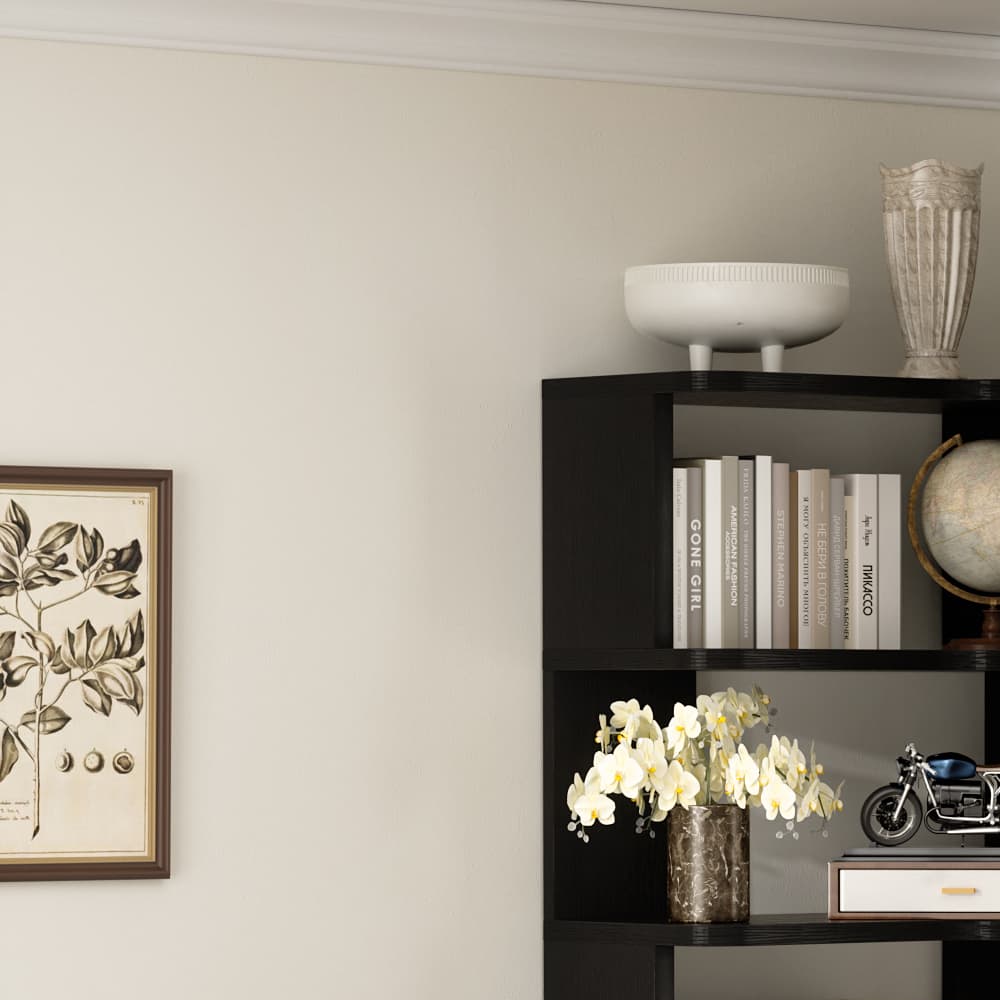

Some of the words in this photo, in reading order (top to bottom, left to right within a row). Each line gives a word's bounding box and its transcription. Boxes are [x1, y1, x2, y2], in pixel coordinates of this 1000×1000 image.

[690, 519, 701, 568] GONE
[730, 505, 738, 560] AMERICAN
[777, 510, 785, 560] STEPHEN
[817, 523, 827, 538] НЕ
[817, 540, 827, 569] БЕРИ
[690, 575, 701, 613] GIRL
[730, 562, 738, 607] FASHION
[777, 563, 785, 608] MARINO
[817, 582, 827, 627] ГОЛОВУ
[862, 565, 873, 617] ПИКАССО
